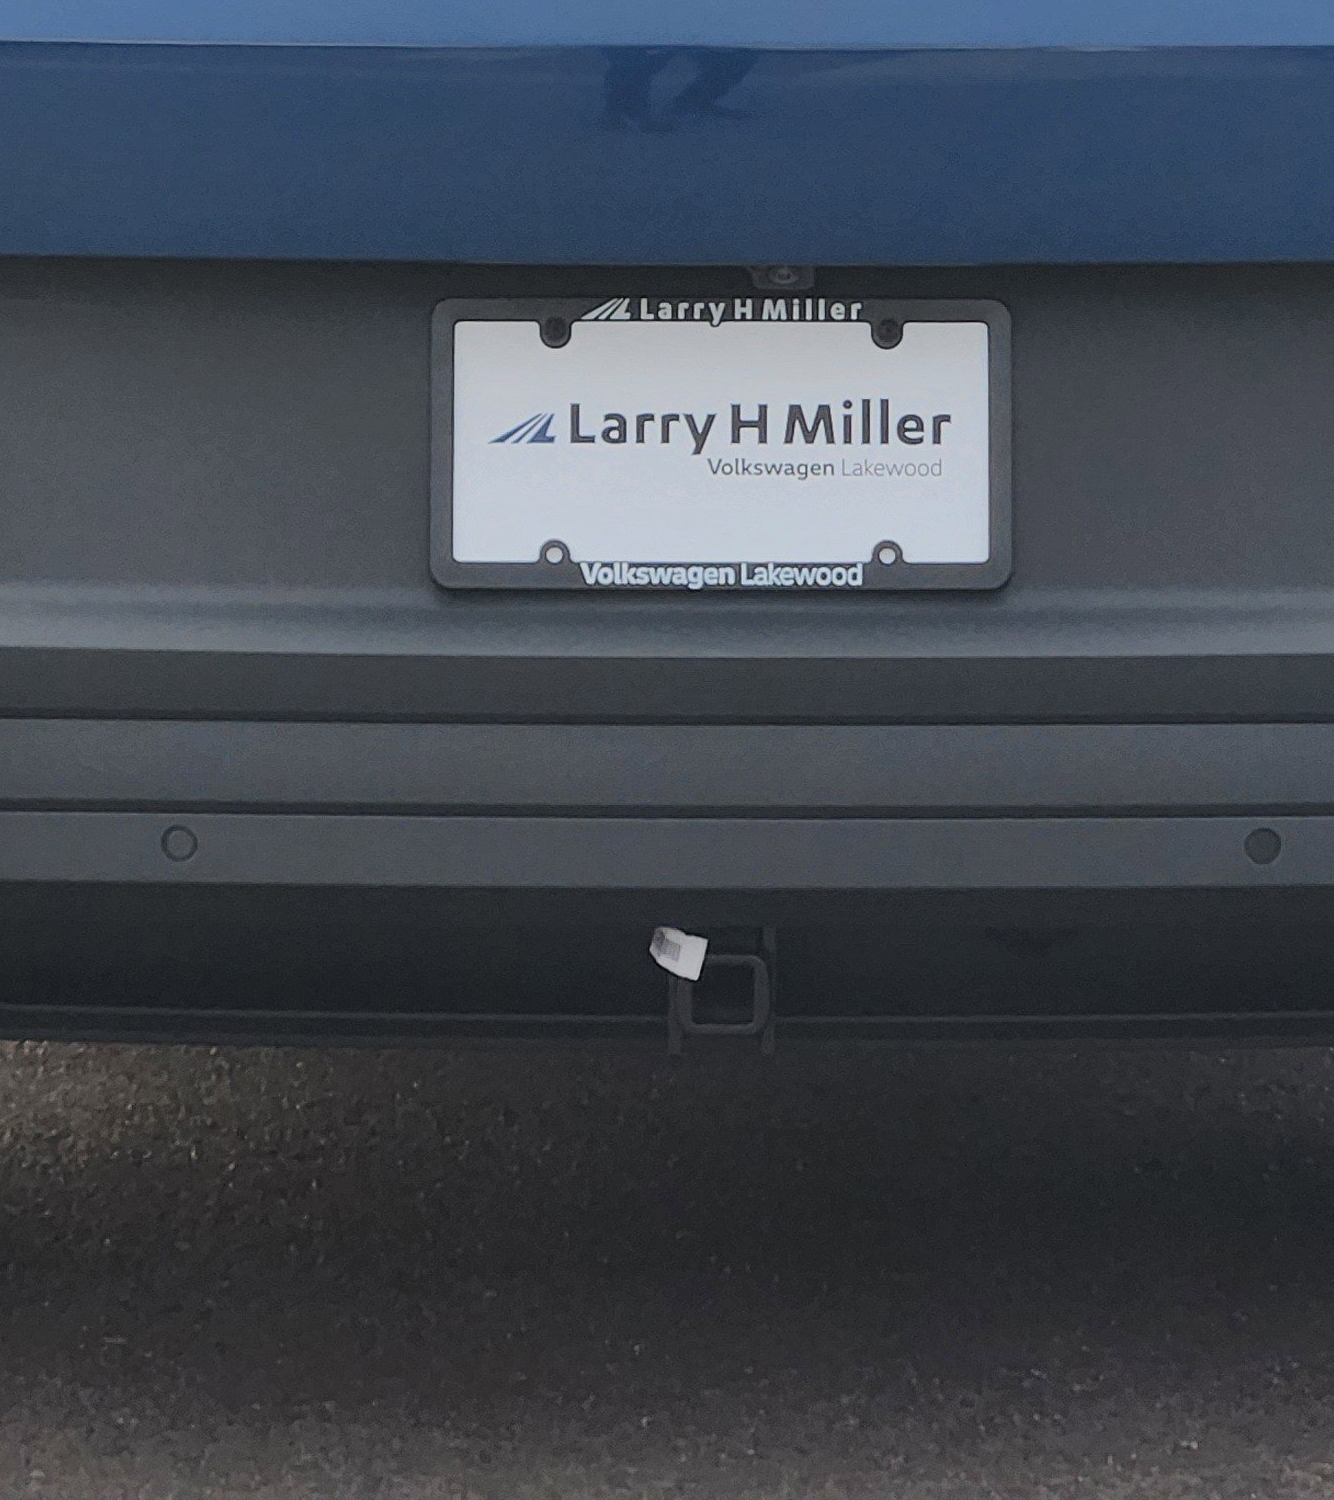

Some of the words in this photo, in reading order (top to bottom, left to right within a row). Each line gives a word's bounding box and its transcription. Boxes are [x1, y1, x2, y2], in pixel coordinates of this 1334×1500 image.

[640, 297, 725, 326] Larry
[734, 298, 753, 320] H
[762, 298, 863, 320] Miller
[569, 402, 717, 455] Larry
[730, 403, 768, 444] H
[783, 398, 952, 445] Miller
[707, 458, 835, 481] Volkswagen
[841, 458, 943, 477] Lakewood
[579, 561, 736, 590] Volkswagen
[740, 562, 864, 586] Lakewood
